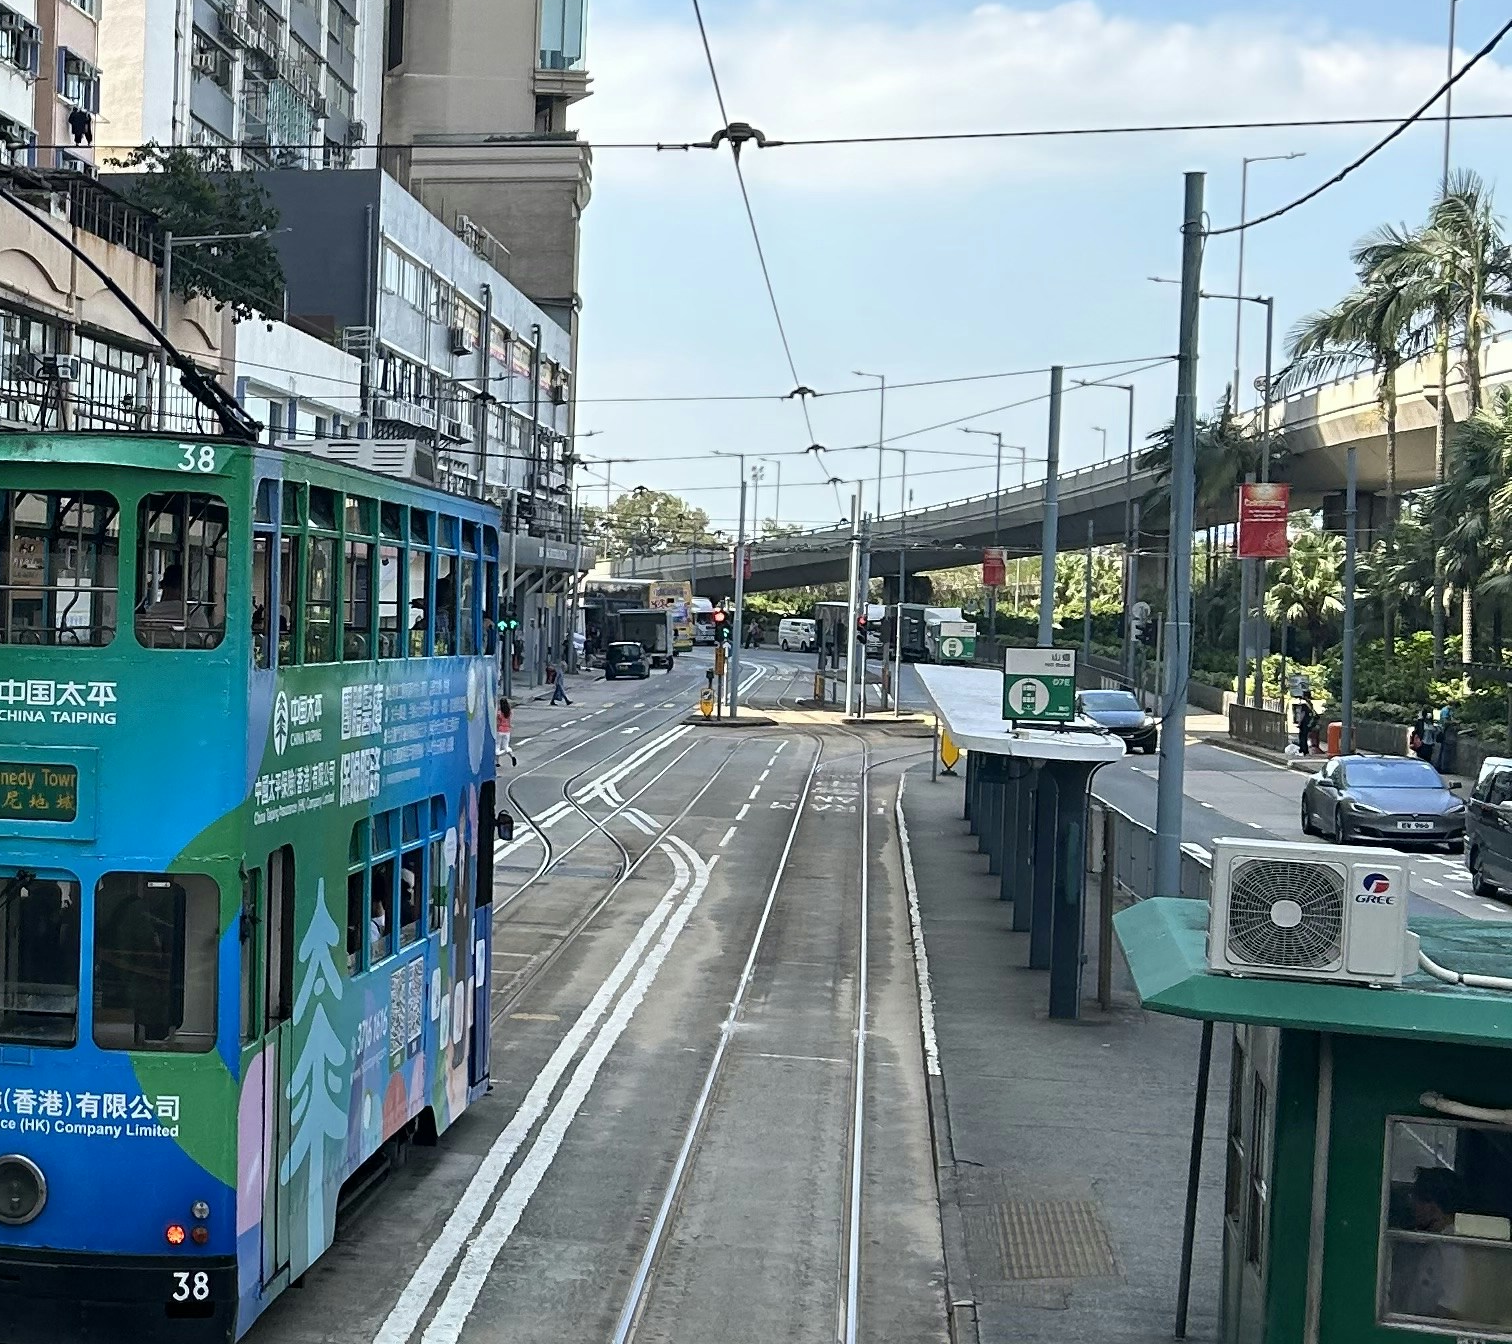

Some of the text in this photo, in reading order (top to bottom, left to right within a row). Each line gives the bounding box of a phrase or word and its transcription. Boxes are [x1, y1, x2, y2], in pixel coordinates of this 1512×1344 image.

[177, 443, 215, 473] 38
[1052, 679, 1070, 687] 07E
[51, 711, 117, 725] TAIPING
[290, 693, 323, 727] 中国太平
[1355, 894, 1395, 905] GREE
[19, 1118, 50, 1135] (HK)
[54, 1121, 122, 1139] Company
[125, 1123, 180, 1139] Limited
[172, 1271, 210, 1301] 38
